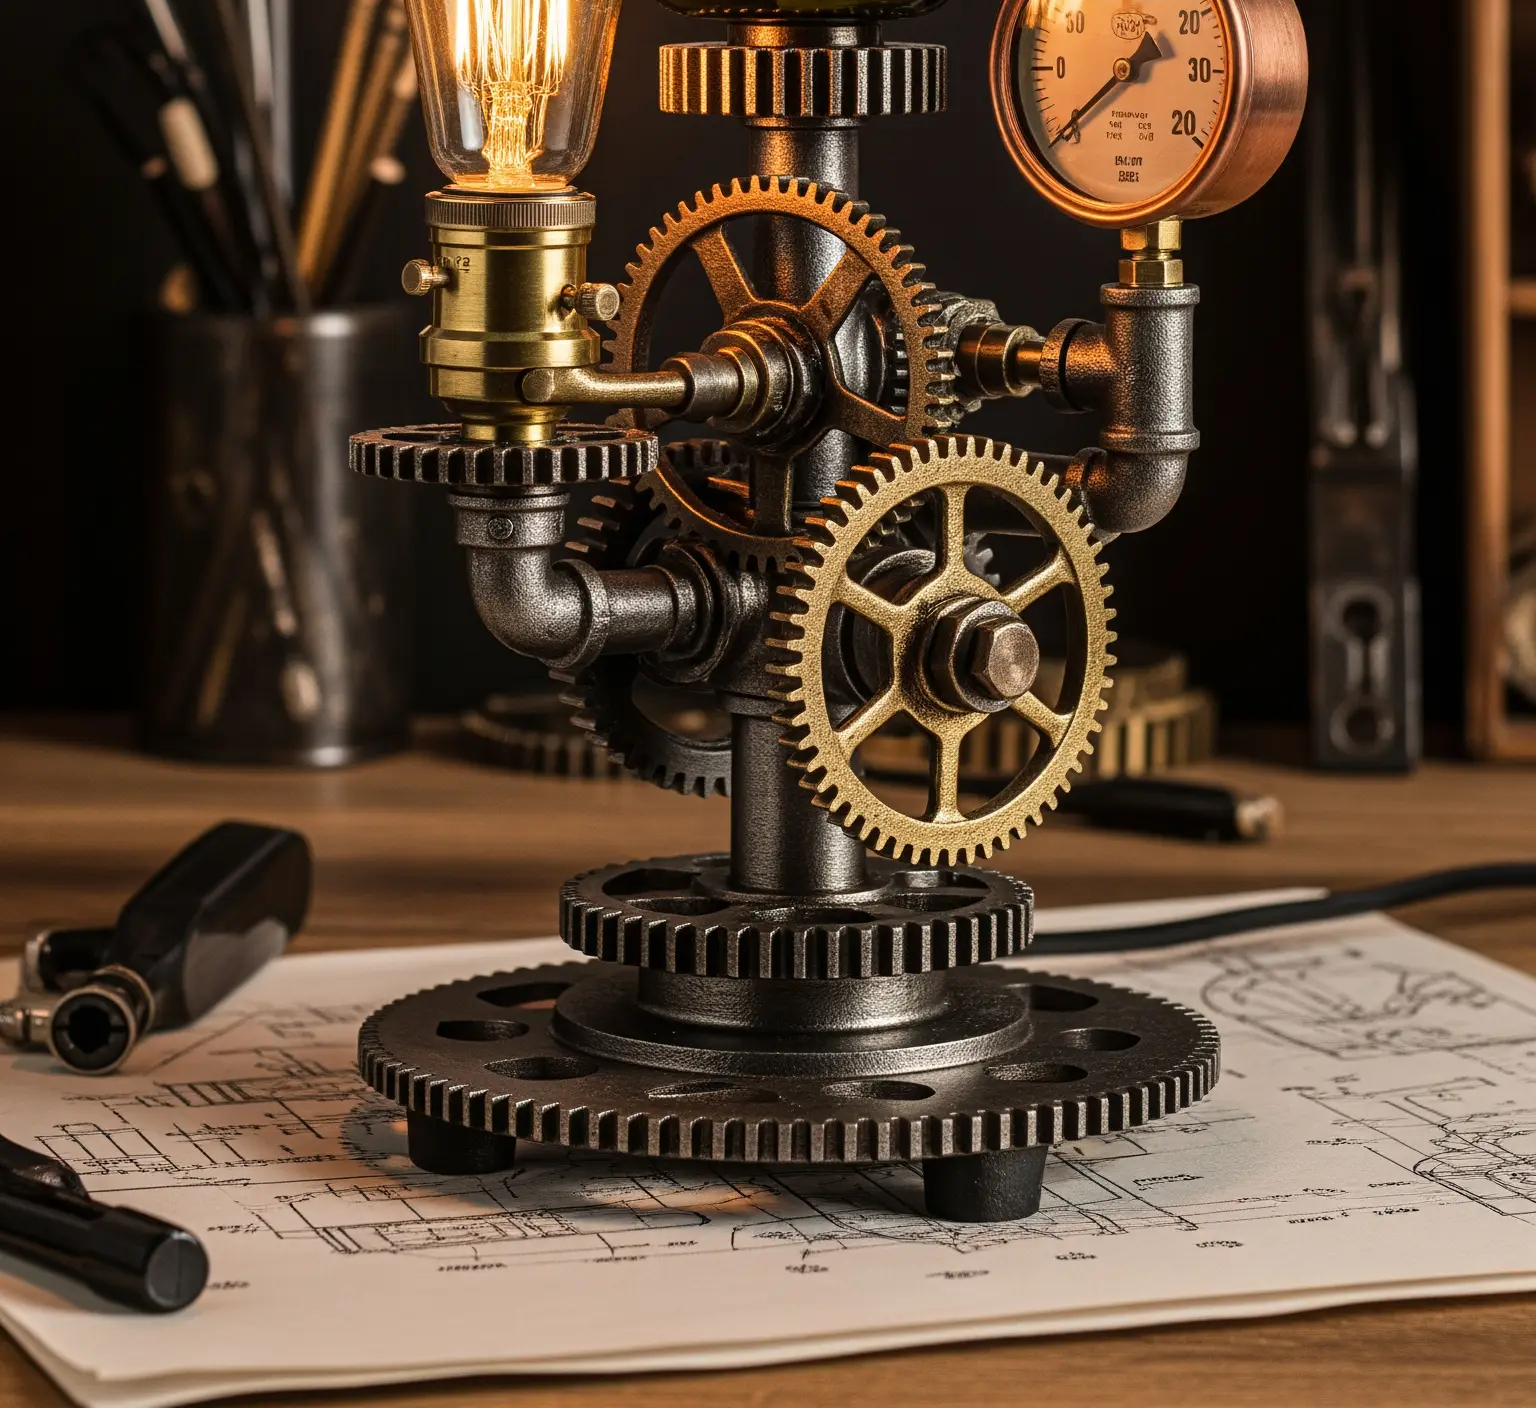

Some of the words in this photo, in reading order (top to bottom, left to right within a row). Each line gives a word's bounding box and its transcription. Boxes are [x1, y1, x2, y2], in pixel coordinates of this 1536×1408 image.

[1178, 9, 1201, 35] 20
[1056, 55, 1066, 80] 0
[1188, 57, 1211, 83] 30
[1171, 109, 1196, 136] 20
